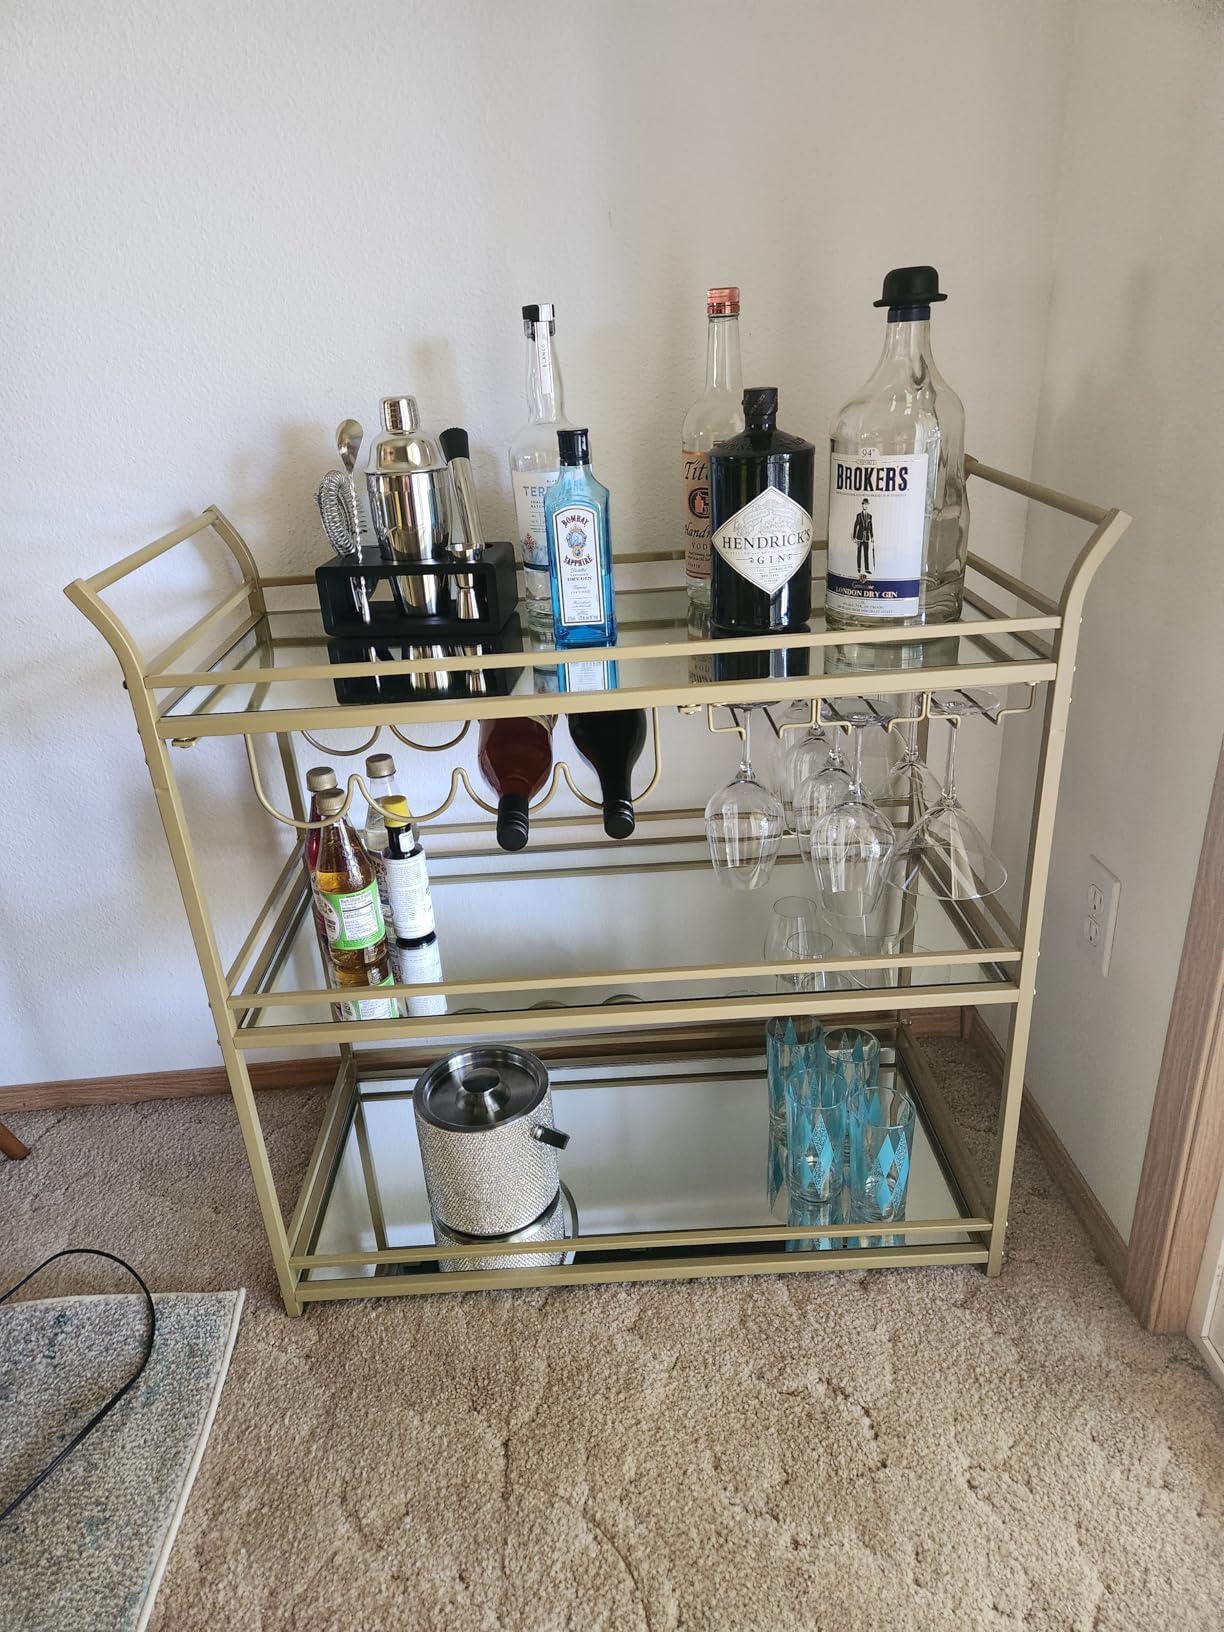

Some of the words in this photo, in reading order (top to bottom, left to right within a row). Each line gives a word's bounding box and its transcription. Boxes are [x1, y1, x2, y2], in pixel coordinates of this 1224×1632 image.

[561, 515, 589, 528] BOMBAY
[722, 528, 811, 550] HENDRICK'S
[563, 554, 593, 567] SAPPHIRE
[757, 554, 785, 565] GIN
[835, 586, 862, 597] LONDON
[863, 590, 880, 598] DRY
